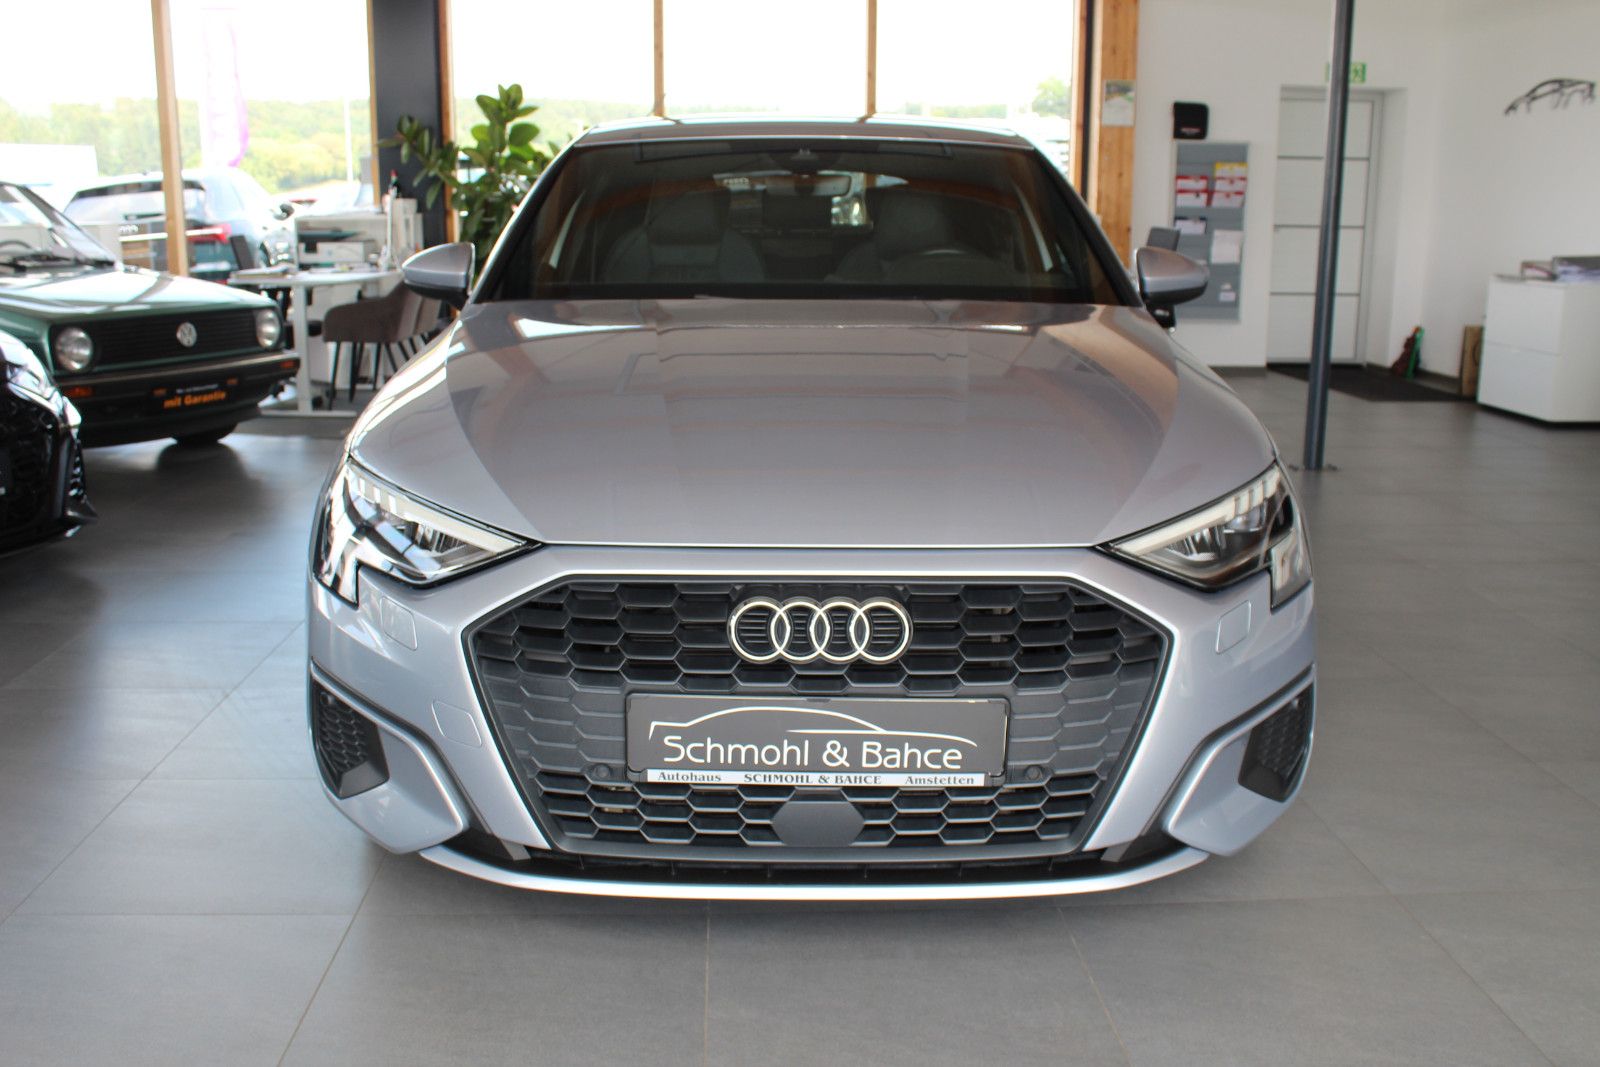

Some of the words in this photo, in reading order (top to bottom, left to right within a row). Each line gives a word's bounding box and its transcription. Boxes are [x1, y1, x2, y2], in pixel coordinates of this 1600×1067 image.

[164, 395, 182, 409] mit
[184, 390, 226, 406] Garantie
[663, 735, 808, 767] Schmohl
[822, 740, 850, 767] &
[861, 741, 963, 769] Bahce
[658, 771, 722, 783] Autohaus
[744, 773, 814, 784] SCHMOHL
[818, 774, 830, 785] &
[834, 774, 882, 785] BAHCE
[905, 774, 975, 786] Amstetten
